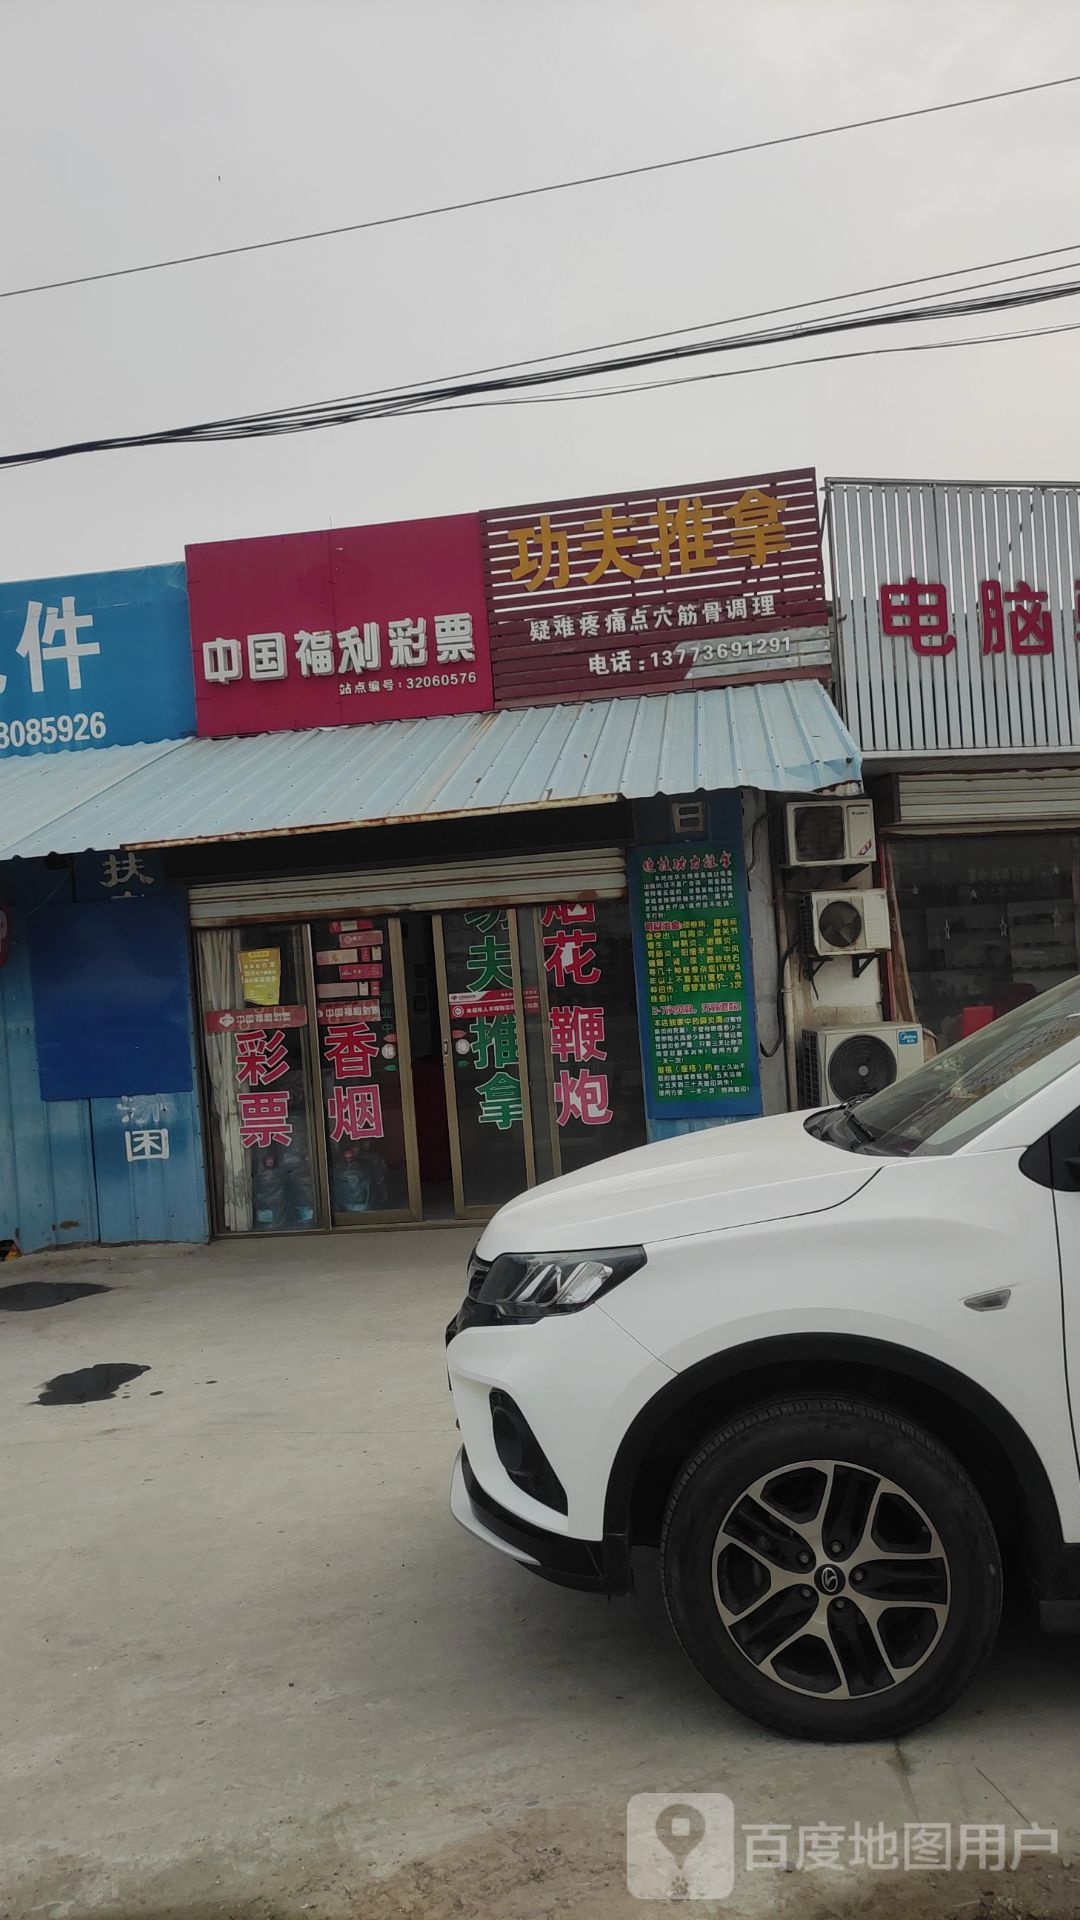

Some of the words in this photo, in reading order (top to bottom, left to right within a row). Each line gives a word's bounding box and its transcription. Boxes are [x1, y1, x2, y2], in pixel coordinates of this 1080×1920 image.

[508, 489, 792, 592] 功夫推拿
[0, 596, 101, 693] 件
[202, 612, 476, 685] 中国福利彩票
[530, 595, 776, 642] 疑难疼痛点穴筋骨调理
[588, 636, 792, 676] 电话：13773691291
[880, 577, 1080, 657] 电脑
[338, 671, 477, 696] 站点编号：32060576
[236, 1030, 293, 1149] 彩票
[324, 1021, 384, 1143] 香烟
